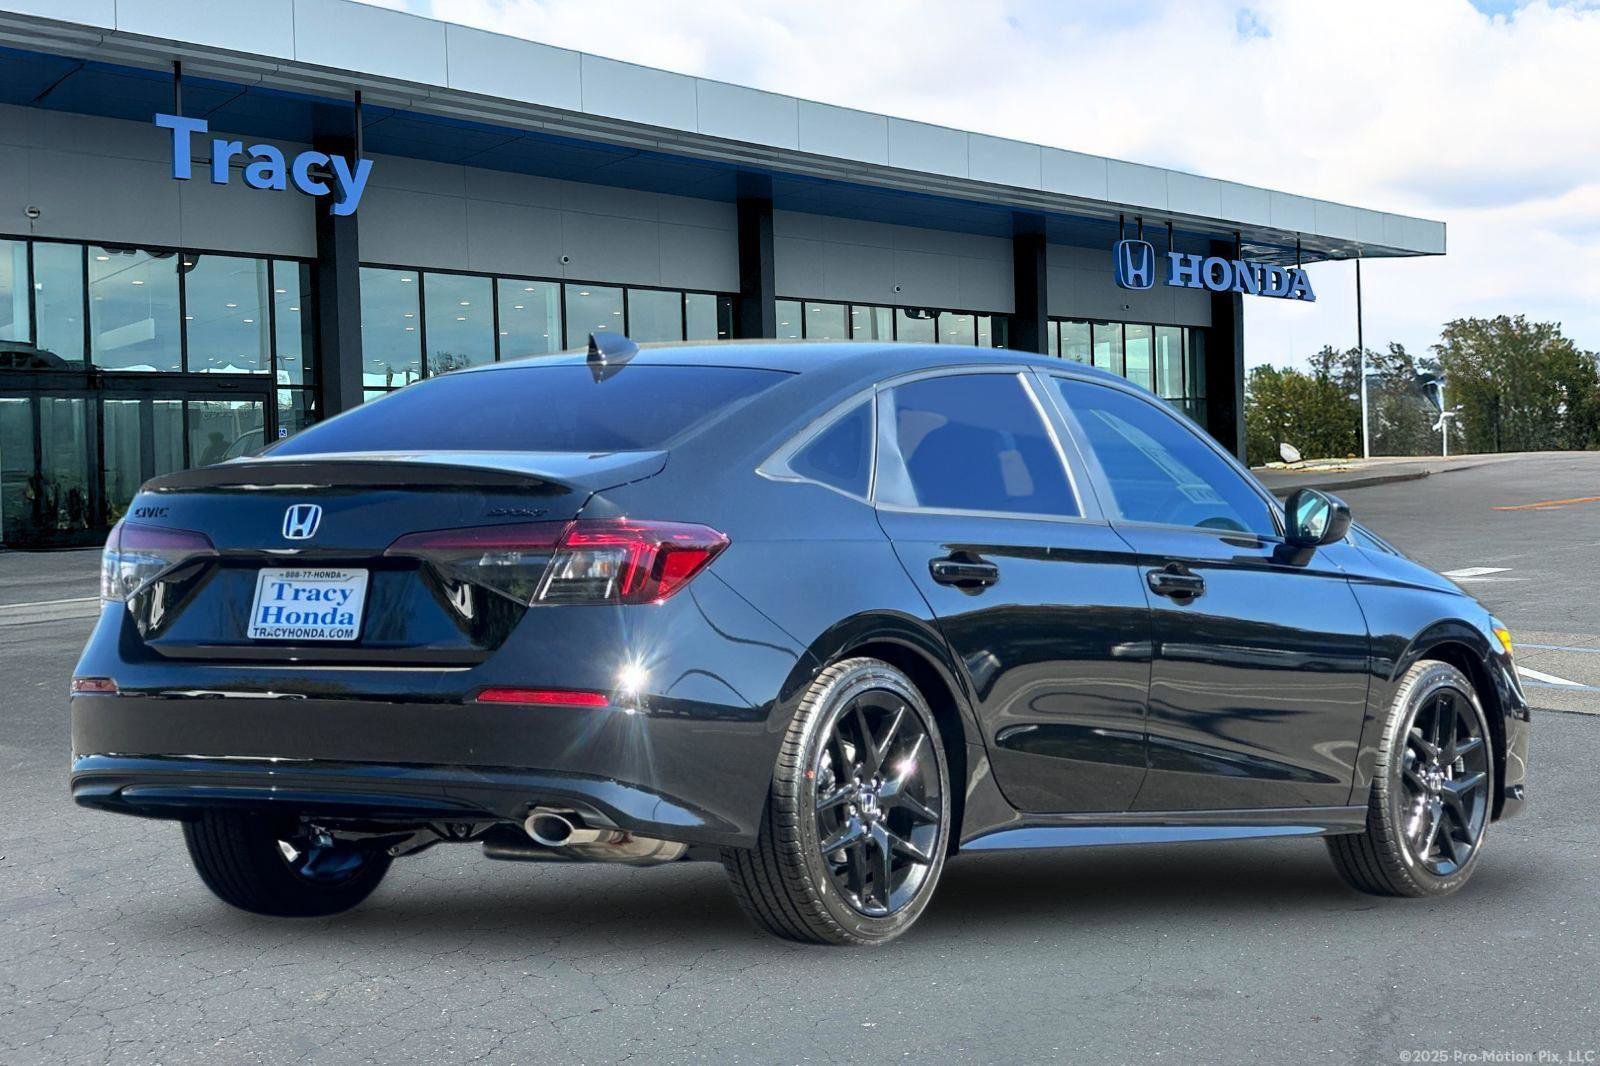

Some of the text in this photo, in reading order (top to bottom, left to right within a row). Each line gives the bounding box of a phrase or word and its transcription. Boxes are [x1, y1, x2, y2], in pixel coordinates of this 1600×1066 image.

[153, 113, 374, 216] Tracy
[1167, 251, 1316, 302] HONDA
[135, 506, 169, 518] CIVIC
[271, 582, 353, 606] Tracy
[261, 606, 354, 625] Honda
[253, 627, 353, 638] TRACYHONDA.COM
